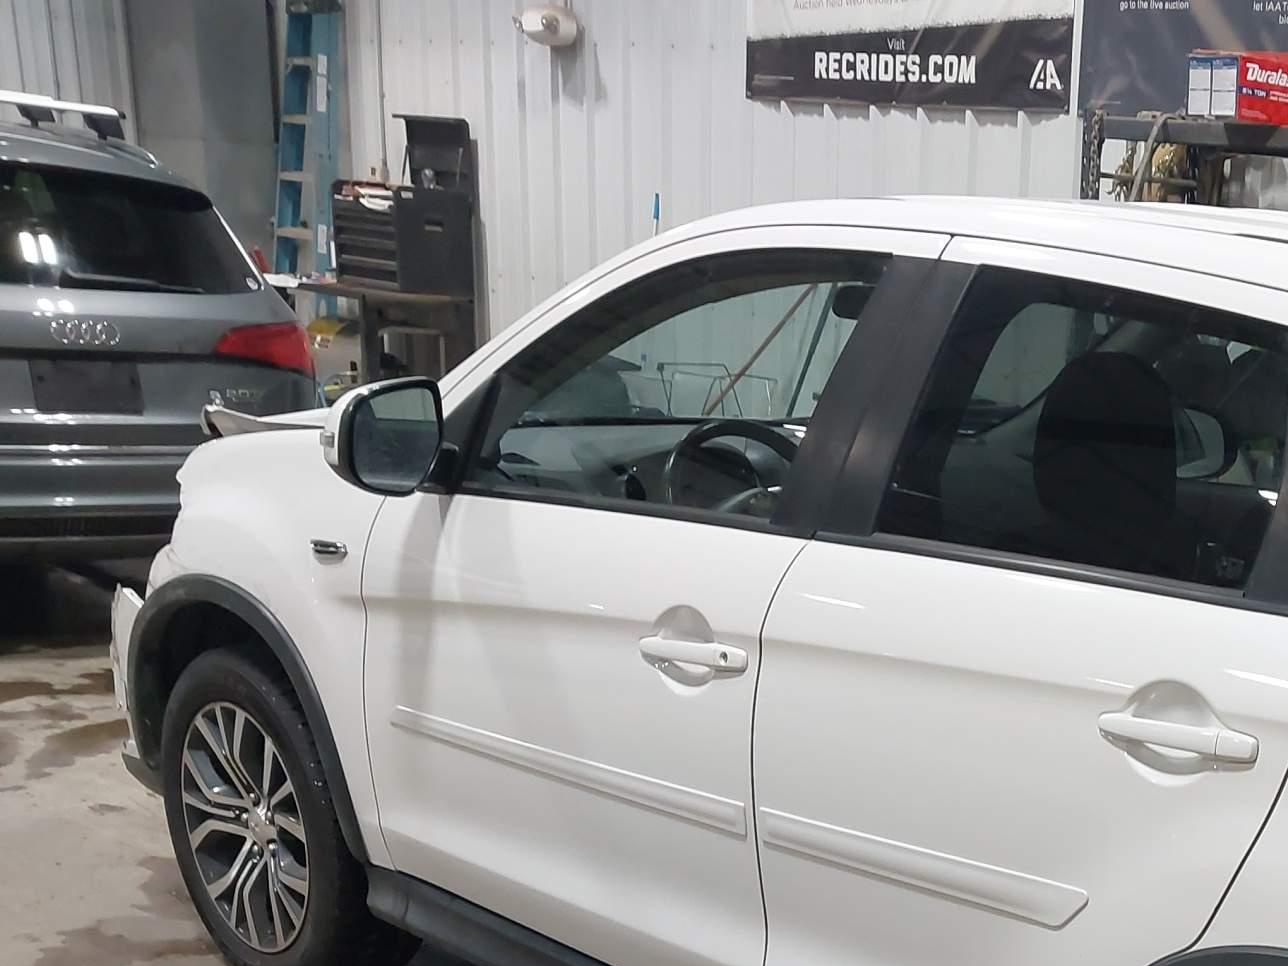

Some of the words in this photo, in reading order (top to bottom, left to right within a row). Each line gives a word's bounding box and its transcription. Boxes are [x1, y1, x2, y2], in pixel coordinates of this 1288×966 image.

[1119, 1, 1129, 11] go
[1129, 0, 1136, 9] to
[1137, 0, 1148, 9] the
[1149, 0, 1163, 9] live
[1164, 0, 1189, 9] auction
[1253, 1, 1263, 11] let
[1265, 1, 1281, 11] IAA
[887, 38, 906, 50] Visit
[814, 51, 977, 83] RECRIDES.COM
